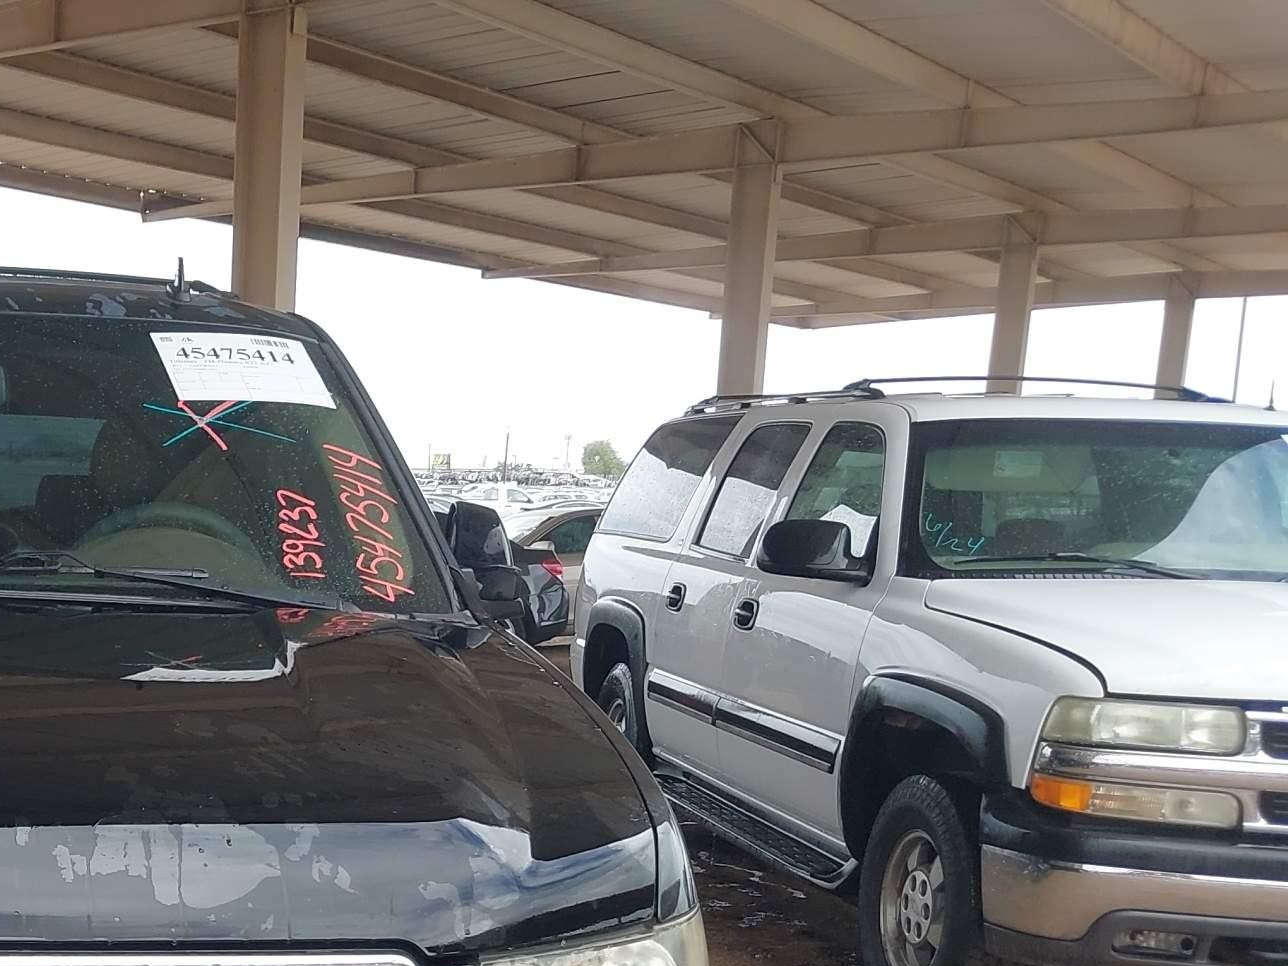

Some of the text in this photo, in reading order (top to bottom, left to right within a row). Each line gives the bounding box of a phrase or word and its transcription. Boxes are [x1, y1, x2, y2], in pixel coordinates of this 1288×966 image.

[176, 347, 295, 365] 45475414
[321, 443, 416, 603] 45475414
[923, 512, 985, 556] 6/24
